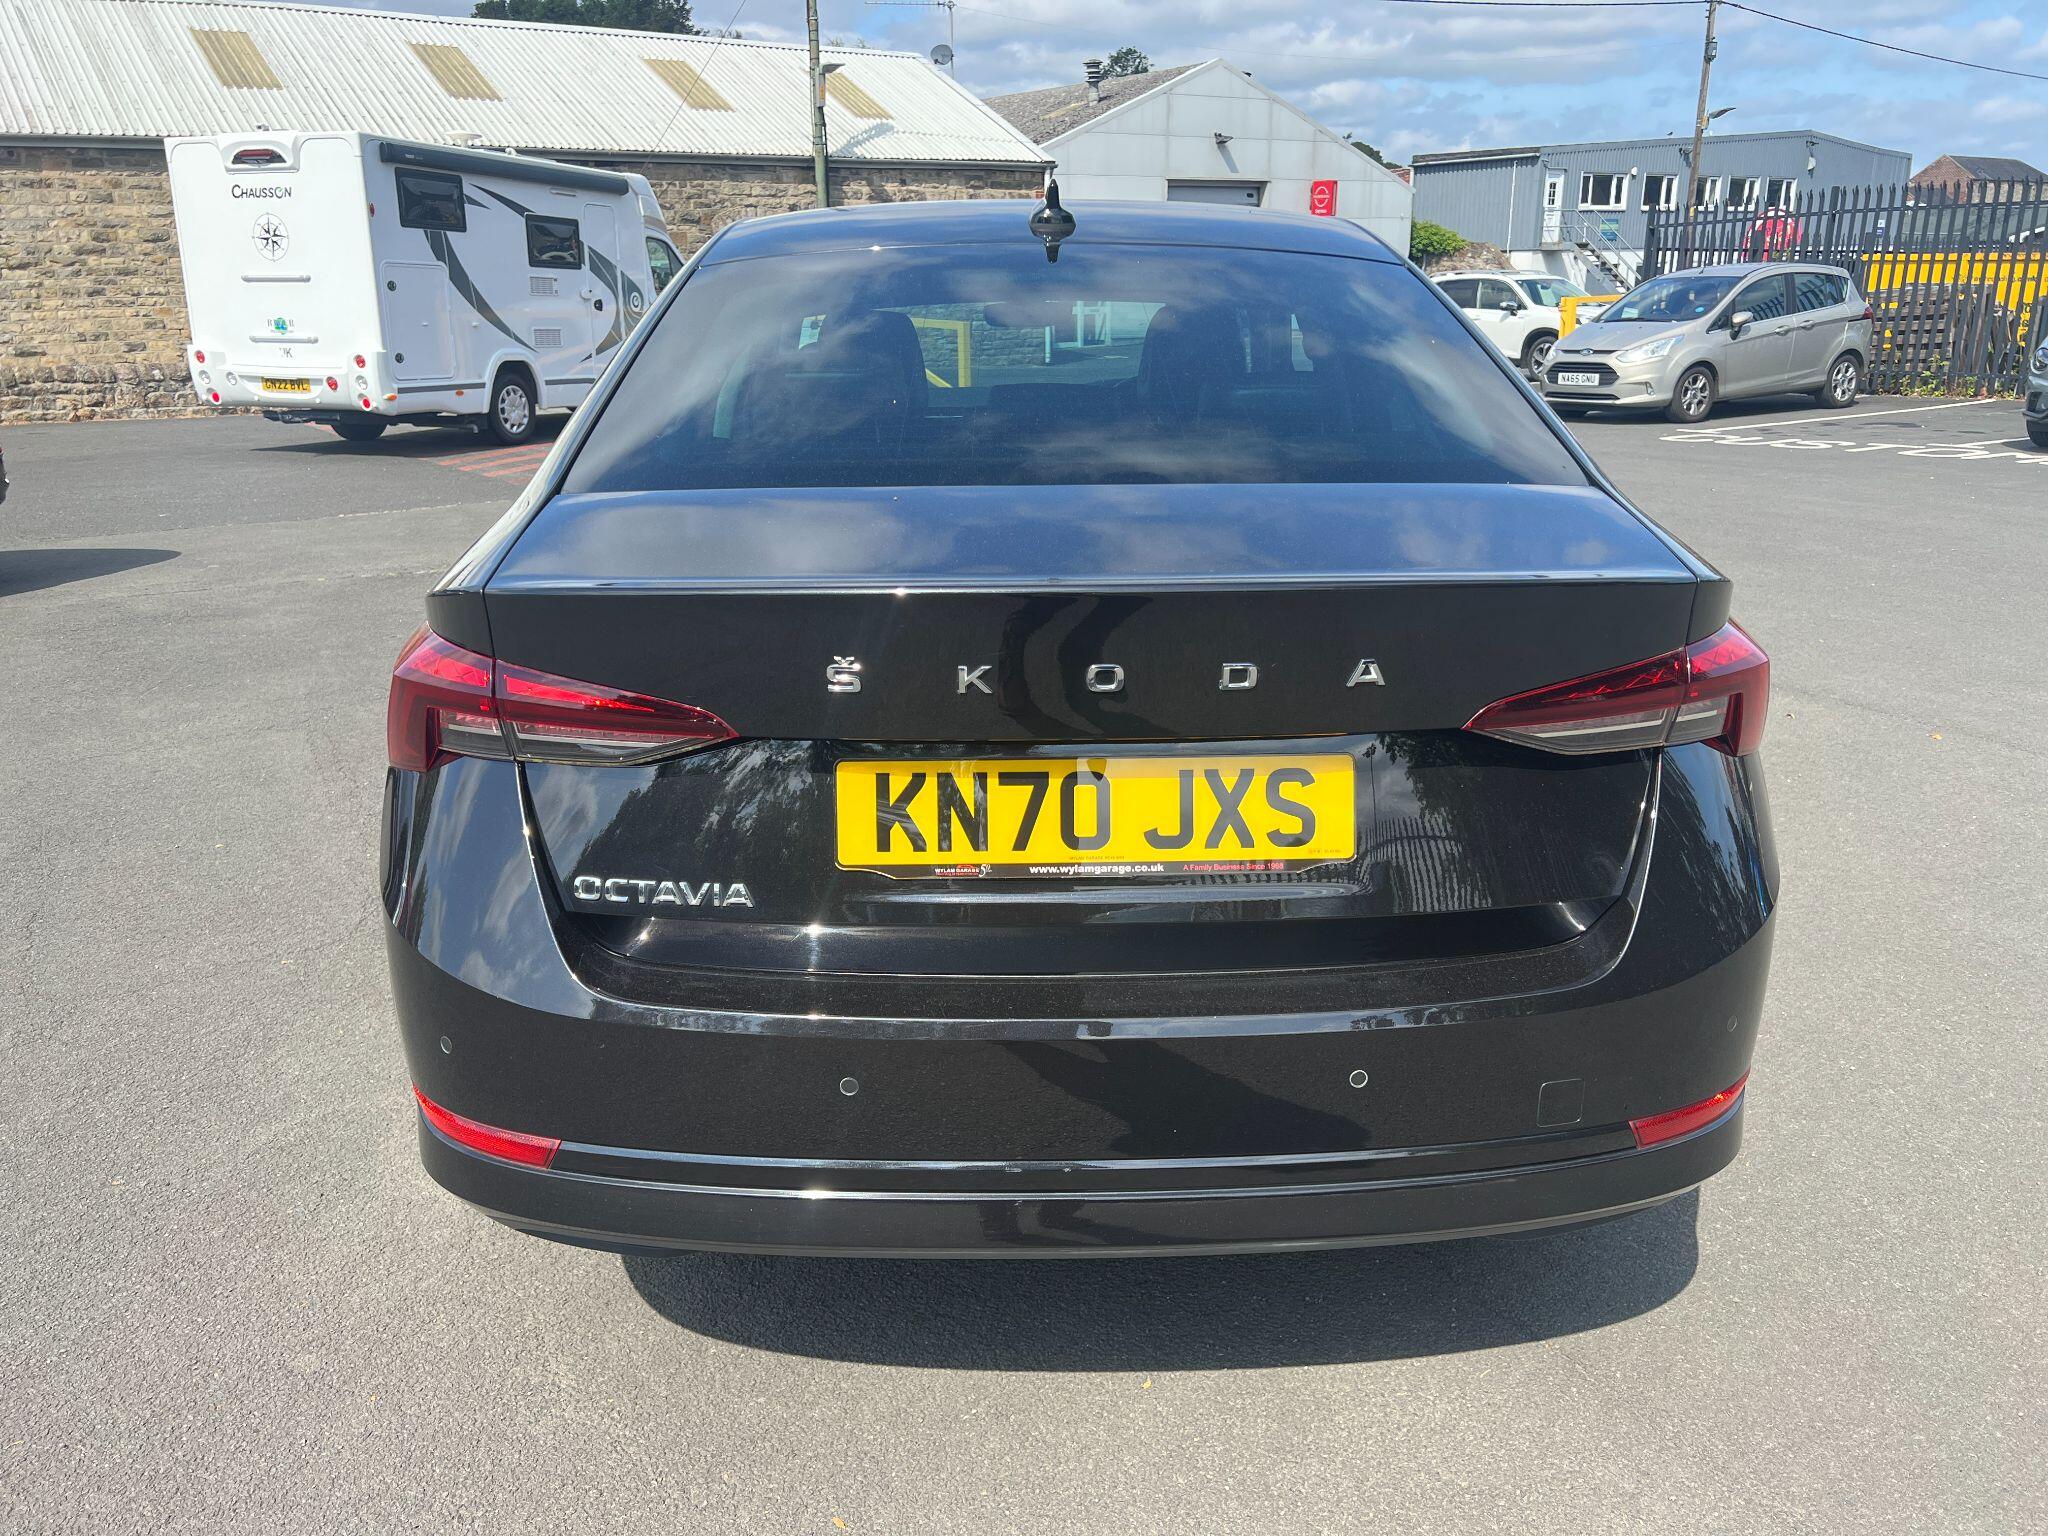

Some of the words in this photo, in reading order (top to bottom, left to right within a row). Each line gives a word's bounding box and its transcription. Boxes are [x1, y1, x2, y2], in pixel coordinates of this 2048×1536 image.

[231, 184, 292, 199] CHAUSSON
[1659, 433, 2048, 466] CUSTOM
[826, 656, 1387, 694] ŠKODA
[875, 770, 1111, 853] KN70
[1143, 767, 1316, 850] JXS
[1029, 863, 1165, 875] www.wylamgarage.co.uk
[1190, 864, 1212, 872] Family
[1213, 863, 1245, 871] Business
[573, 875, 755, 908] OCTAVIA
